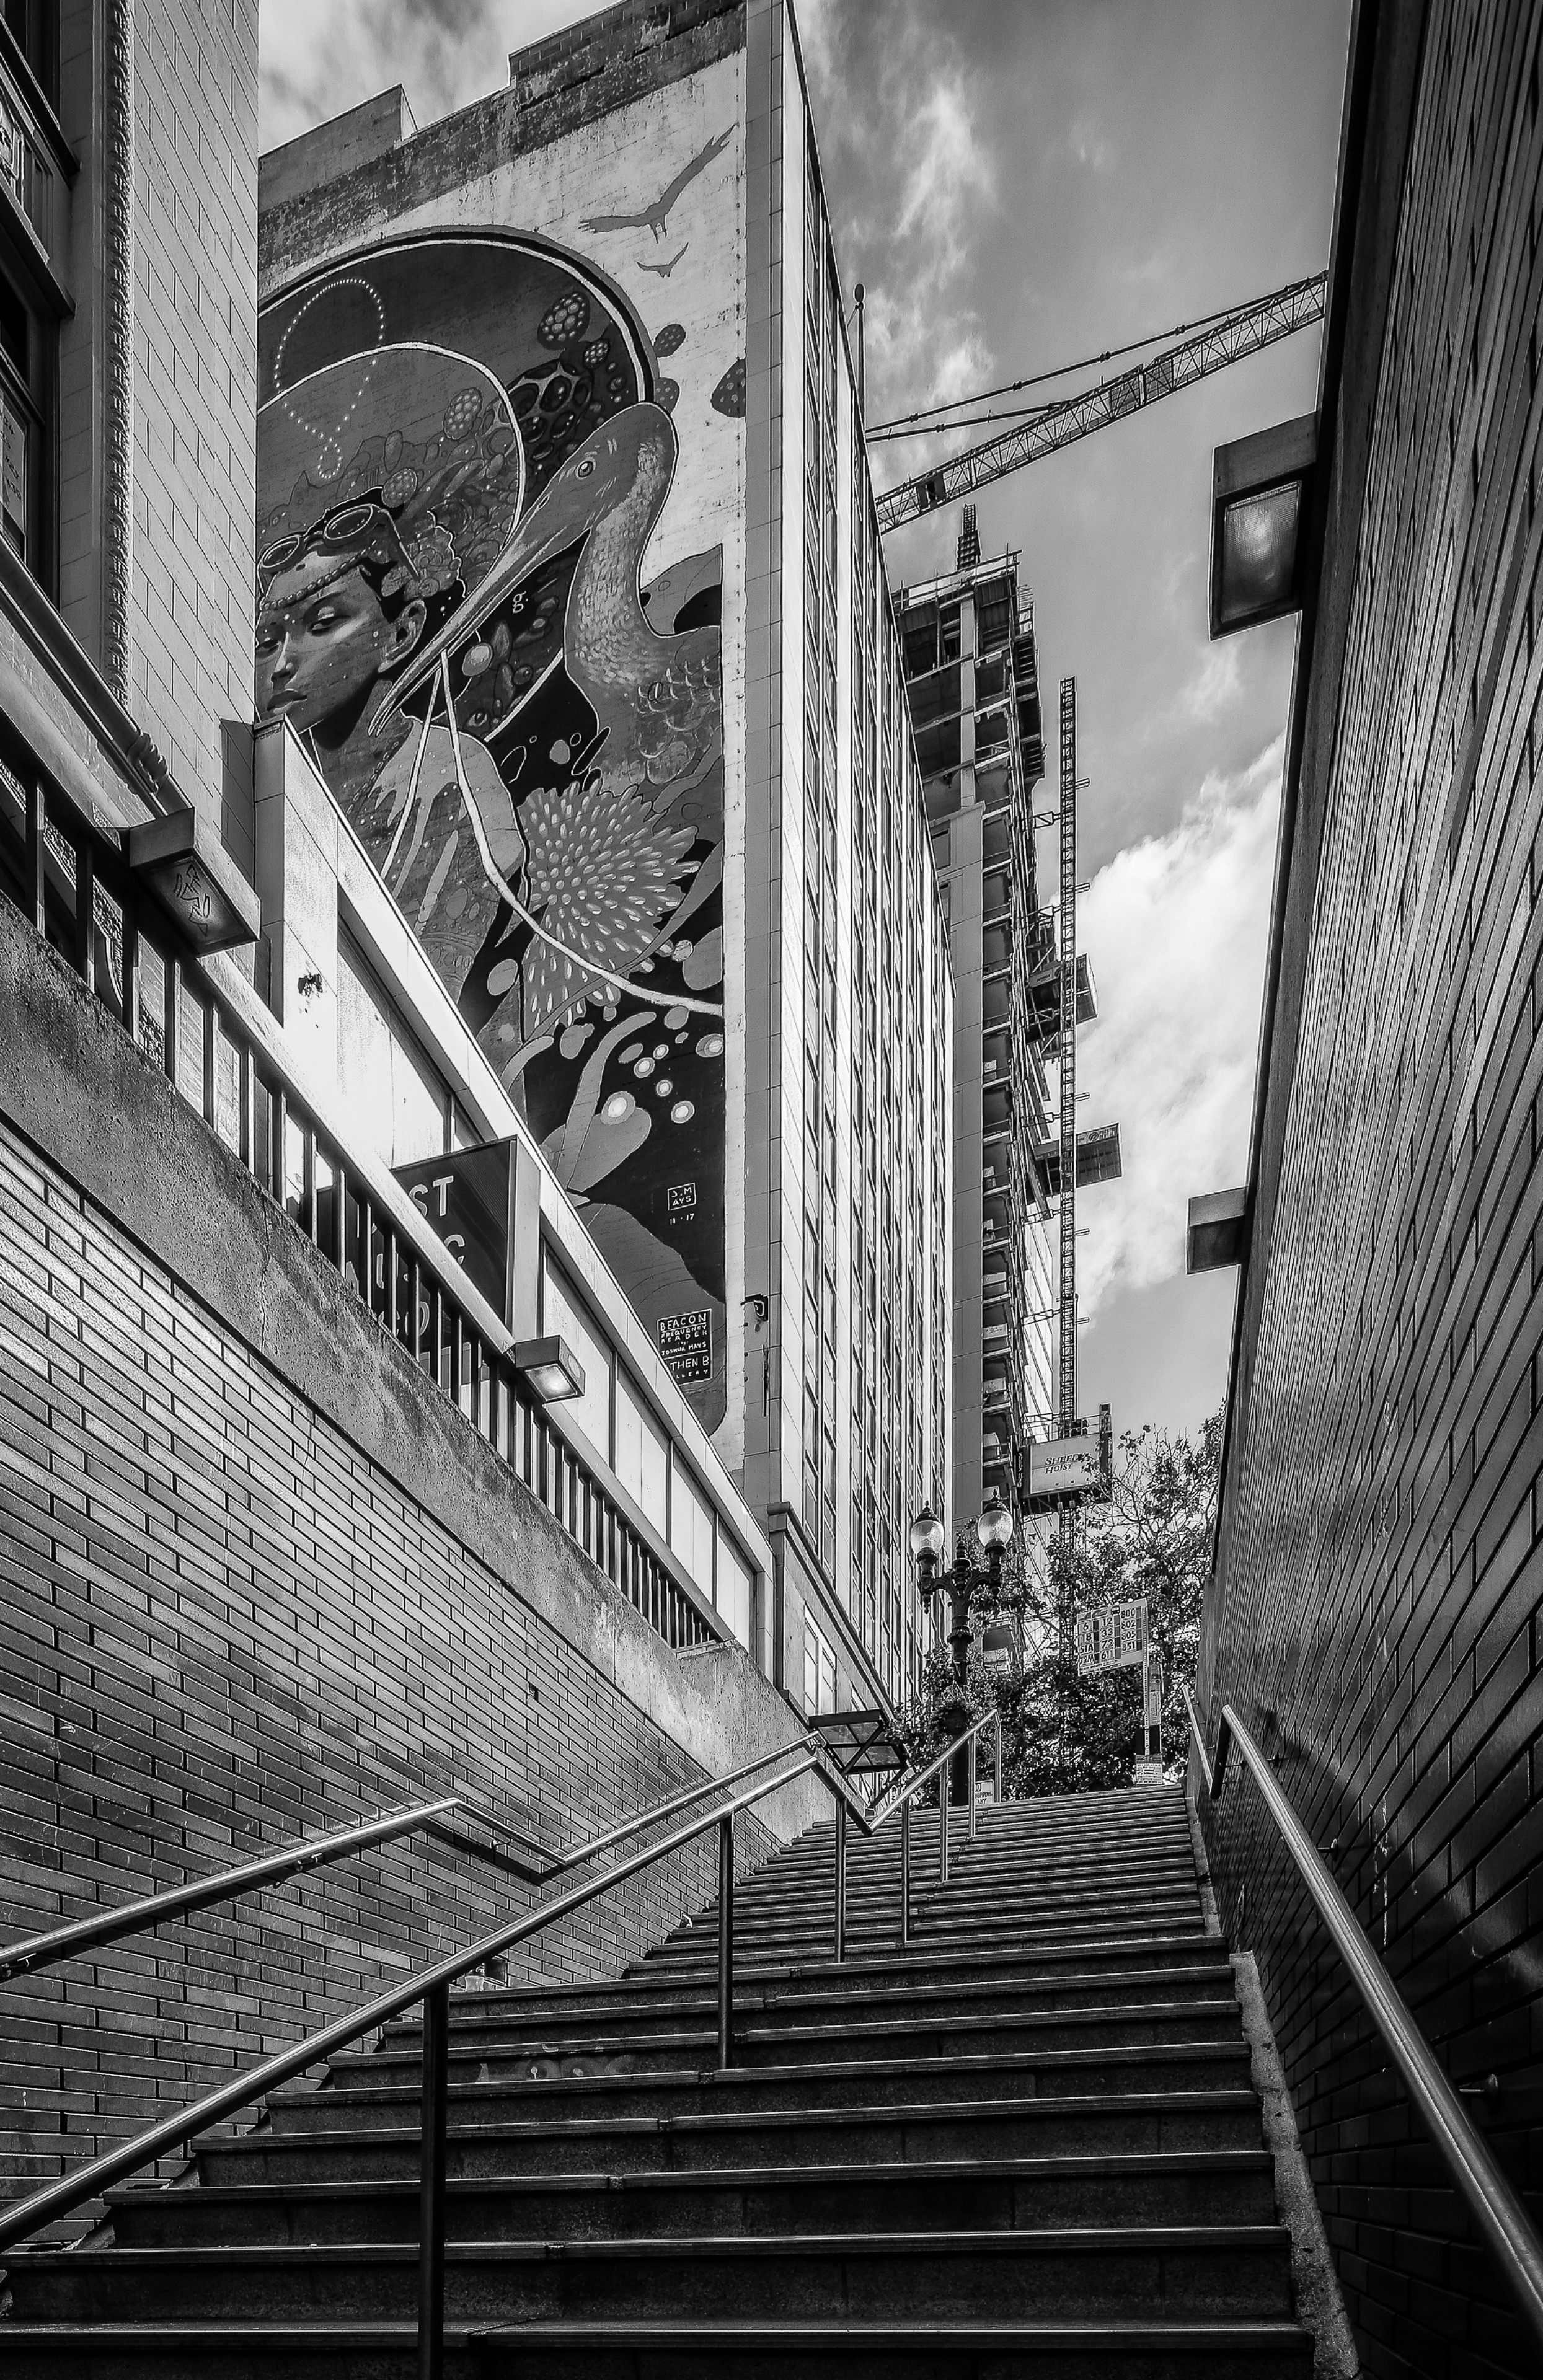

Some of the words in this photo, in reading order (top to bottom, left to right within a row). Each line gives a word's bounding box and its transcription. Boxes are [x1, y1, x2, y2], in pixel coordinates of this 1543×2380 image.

[672, 1195, 692, 1206] AYS
[660, 1312, 707, 1331] BEACON
[661, 1324, 707, 1338] FREQUENCY
[661, 1346, 686, 1356] JOSHUA
[689, 1341, 707, 1350] MAYS
[670, 1357, 698, 1372] THEN
[702, 1355, 709, 1366] B
[676, 1369, 709, 1378] LLERY
[1045, 1453, 1086, 1466] SHEED
[1045, 1464, 1072, 1474] HOIST
[1120, 1608, 1135, 1618] 800
[1103, 1617, 1113, 1626] 12
[1121, 1619, 1135, 1629] 802
[1083, 1623, 1089, 1631] 6
[1081, 1633, 1092, 1642] 18
[1102, 1628, 1113, 1637] 33
[1121, 1630, 1136, 1640] 805
[1079, 1644, 1094, 1654] 51A
[1102, 1639, 1113, 1649] 72
[1121, 1641, 1135, 1652] 851
[1102, 1650, 1113, 1659] 611
